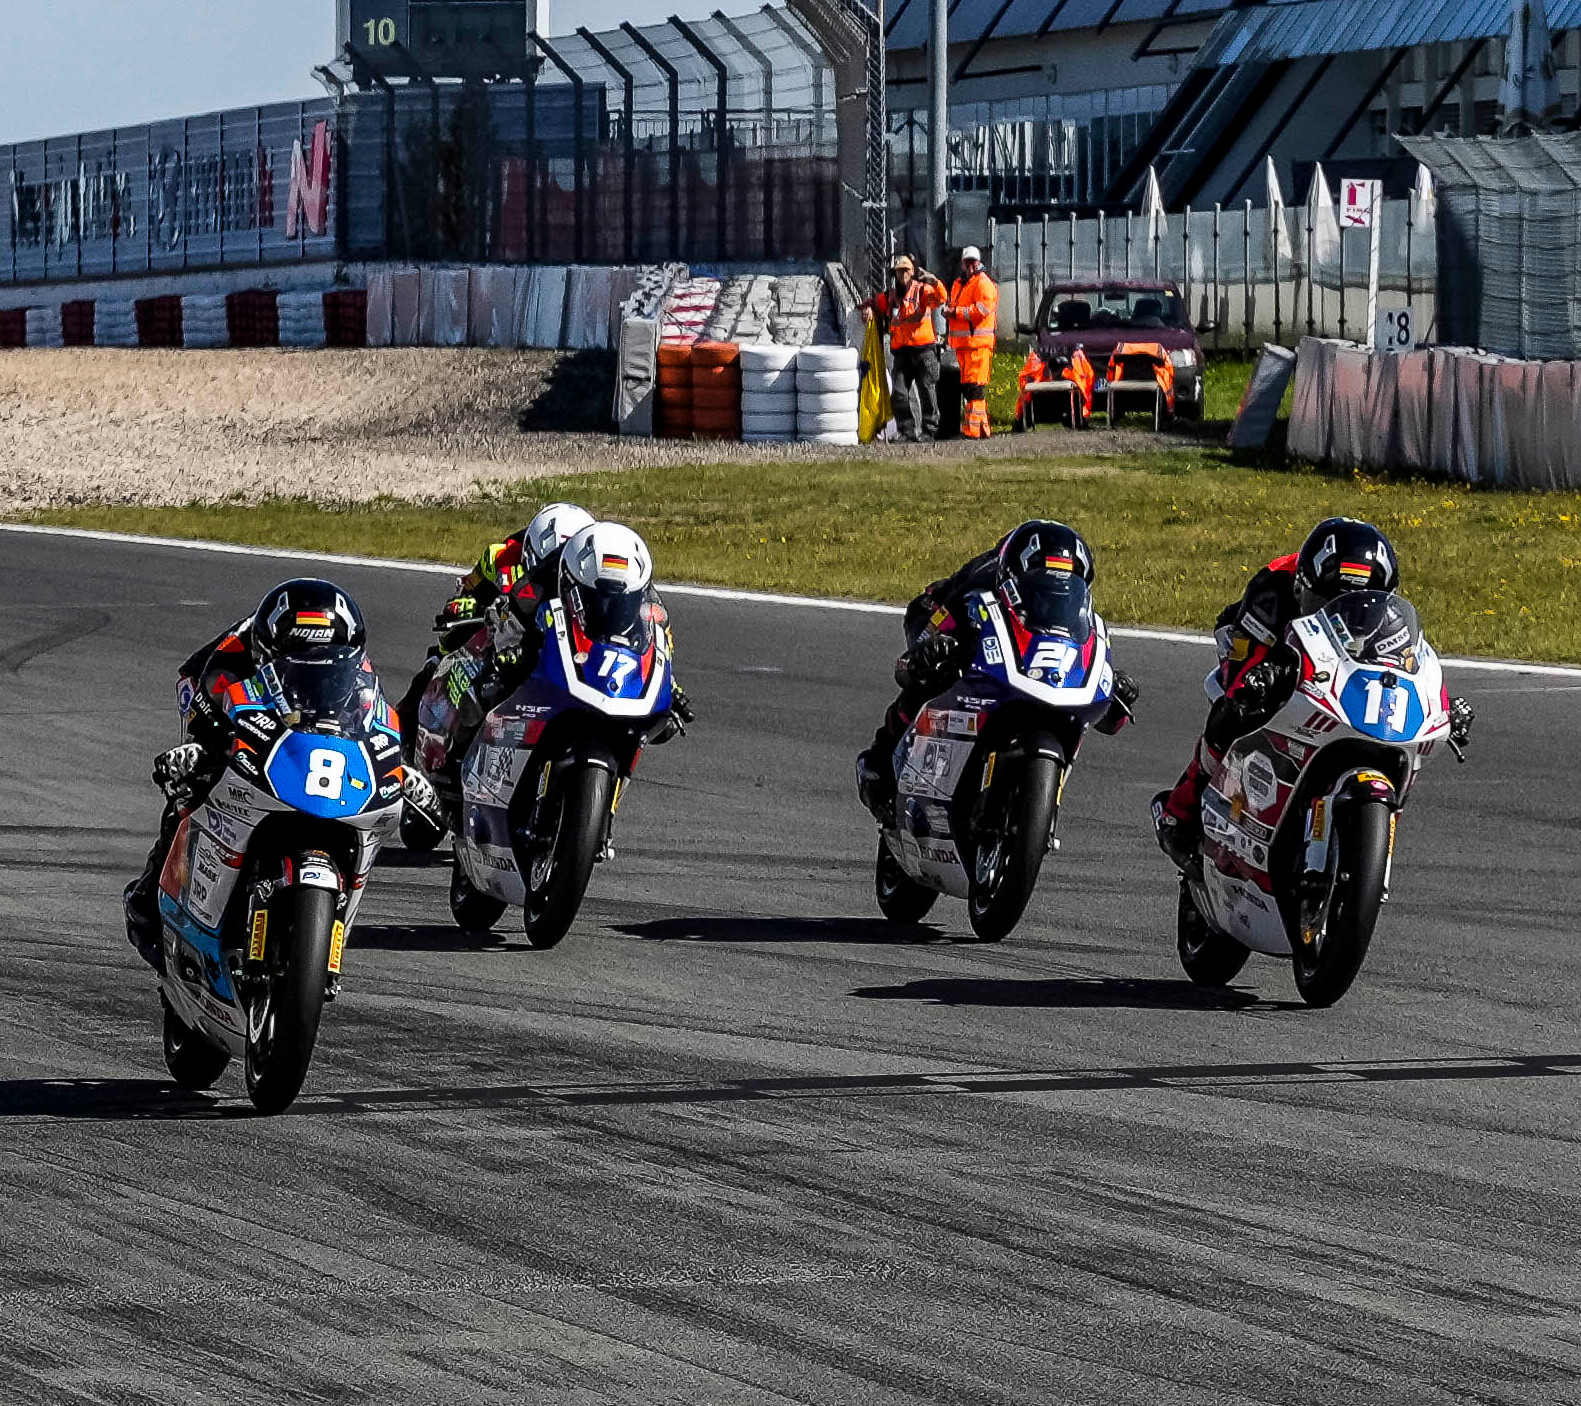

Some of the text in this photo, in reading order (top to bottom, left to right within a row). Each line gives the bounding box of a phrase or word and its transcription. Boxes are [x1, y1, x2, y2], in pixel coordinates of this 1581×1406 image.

[364, 17, 396, 46] 10
[289, 627, 336, 643] NOLAN
[598, 650, 638, 698] 17
[248, 711, 277, 732] JRP
[1362, 678, 1410, 734] 11
[305, 748, 346, 800] 8
